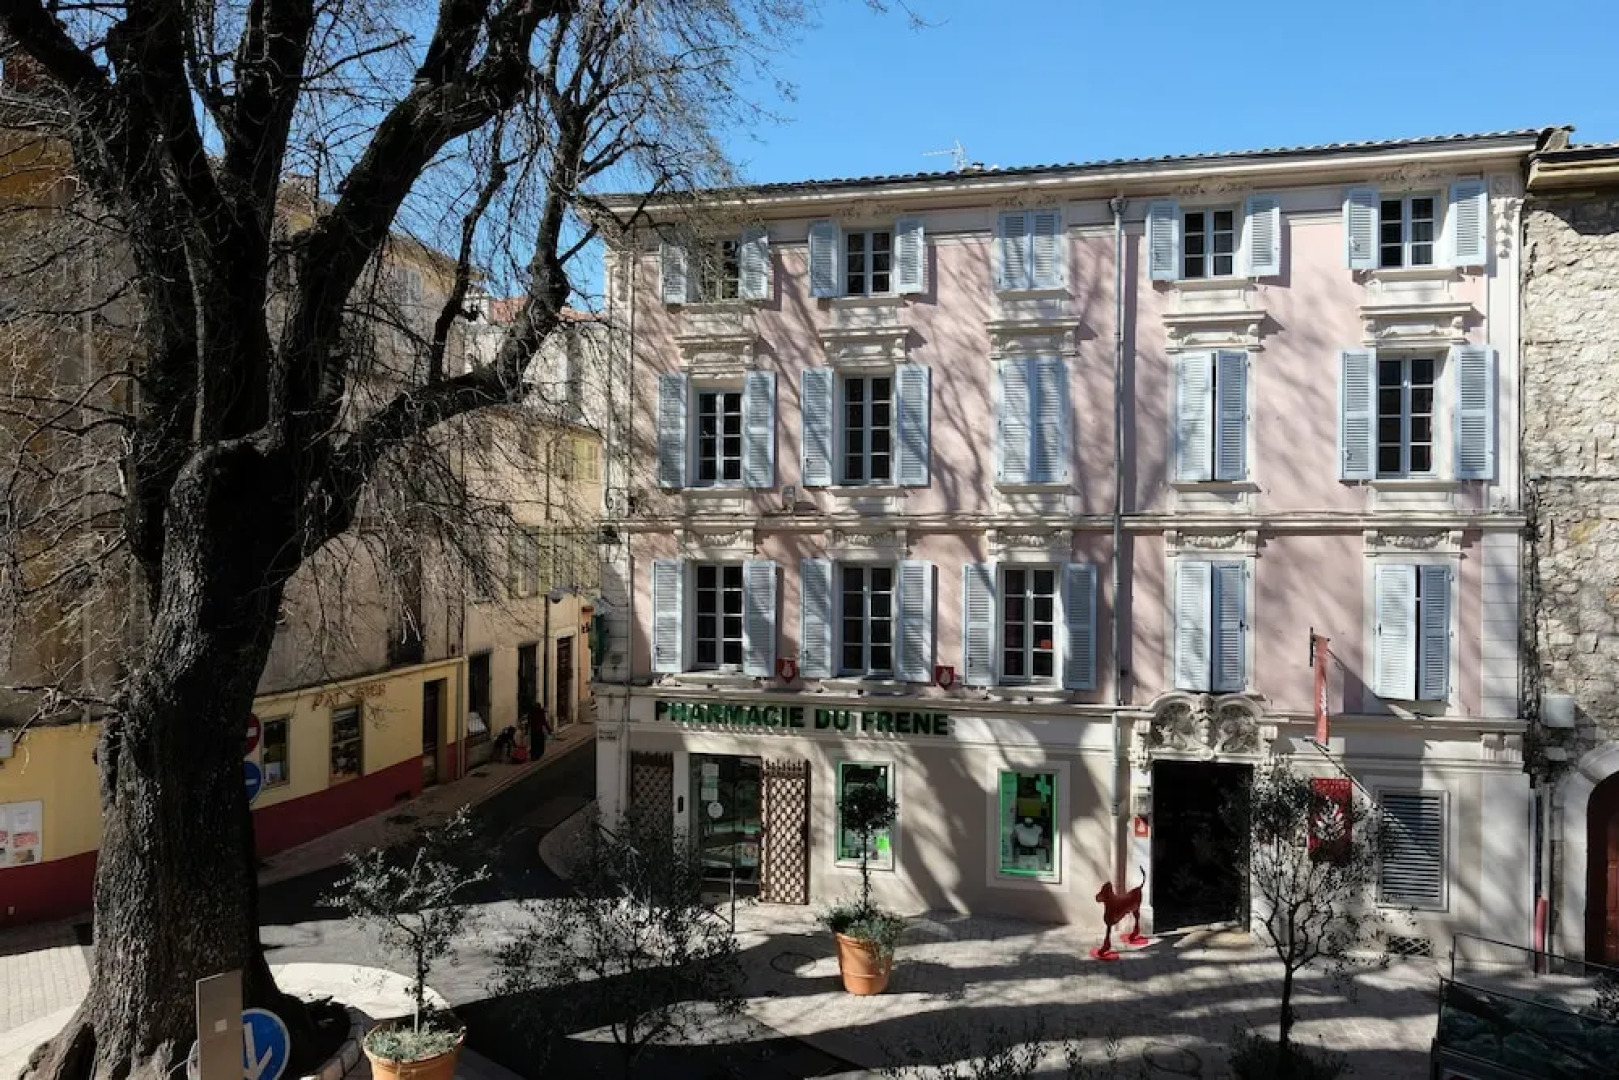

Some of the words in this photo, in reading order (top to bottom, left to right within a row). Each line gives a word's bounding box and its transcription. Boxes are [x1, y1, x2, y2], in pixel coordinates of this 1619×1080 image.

[654, 700, 805, 728] PHARMACIE
[815, 708, 850, 731] DU
[861, 710, 949, 735] FRENE
